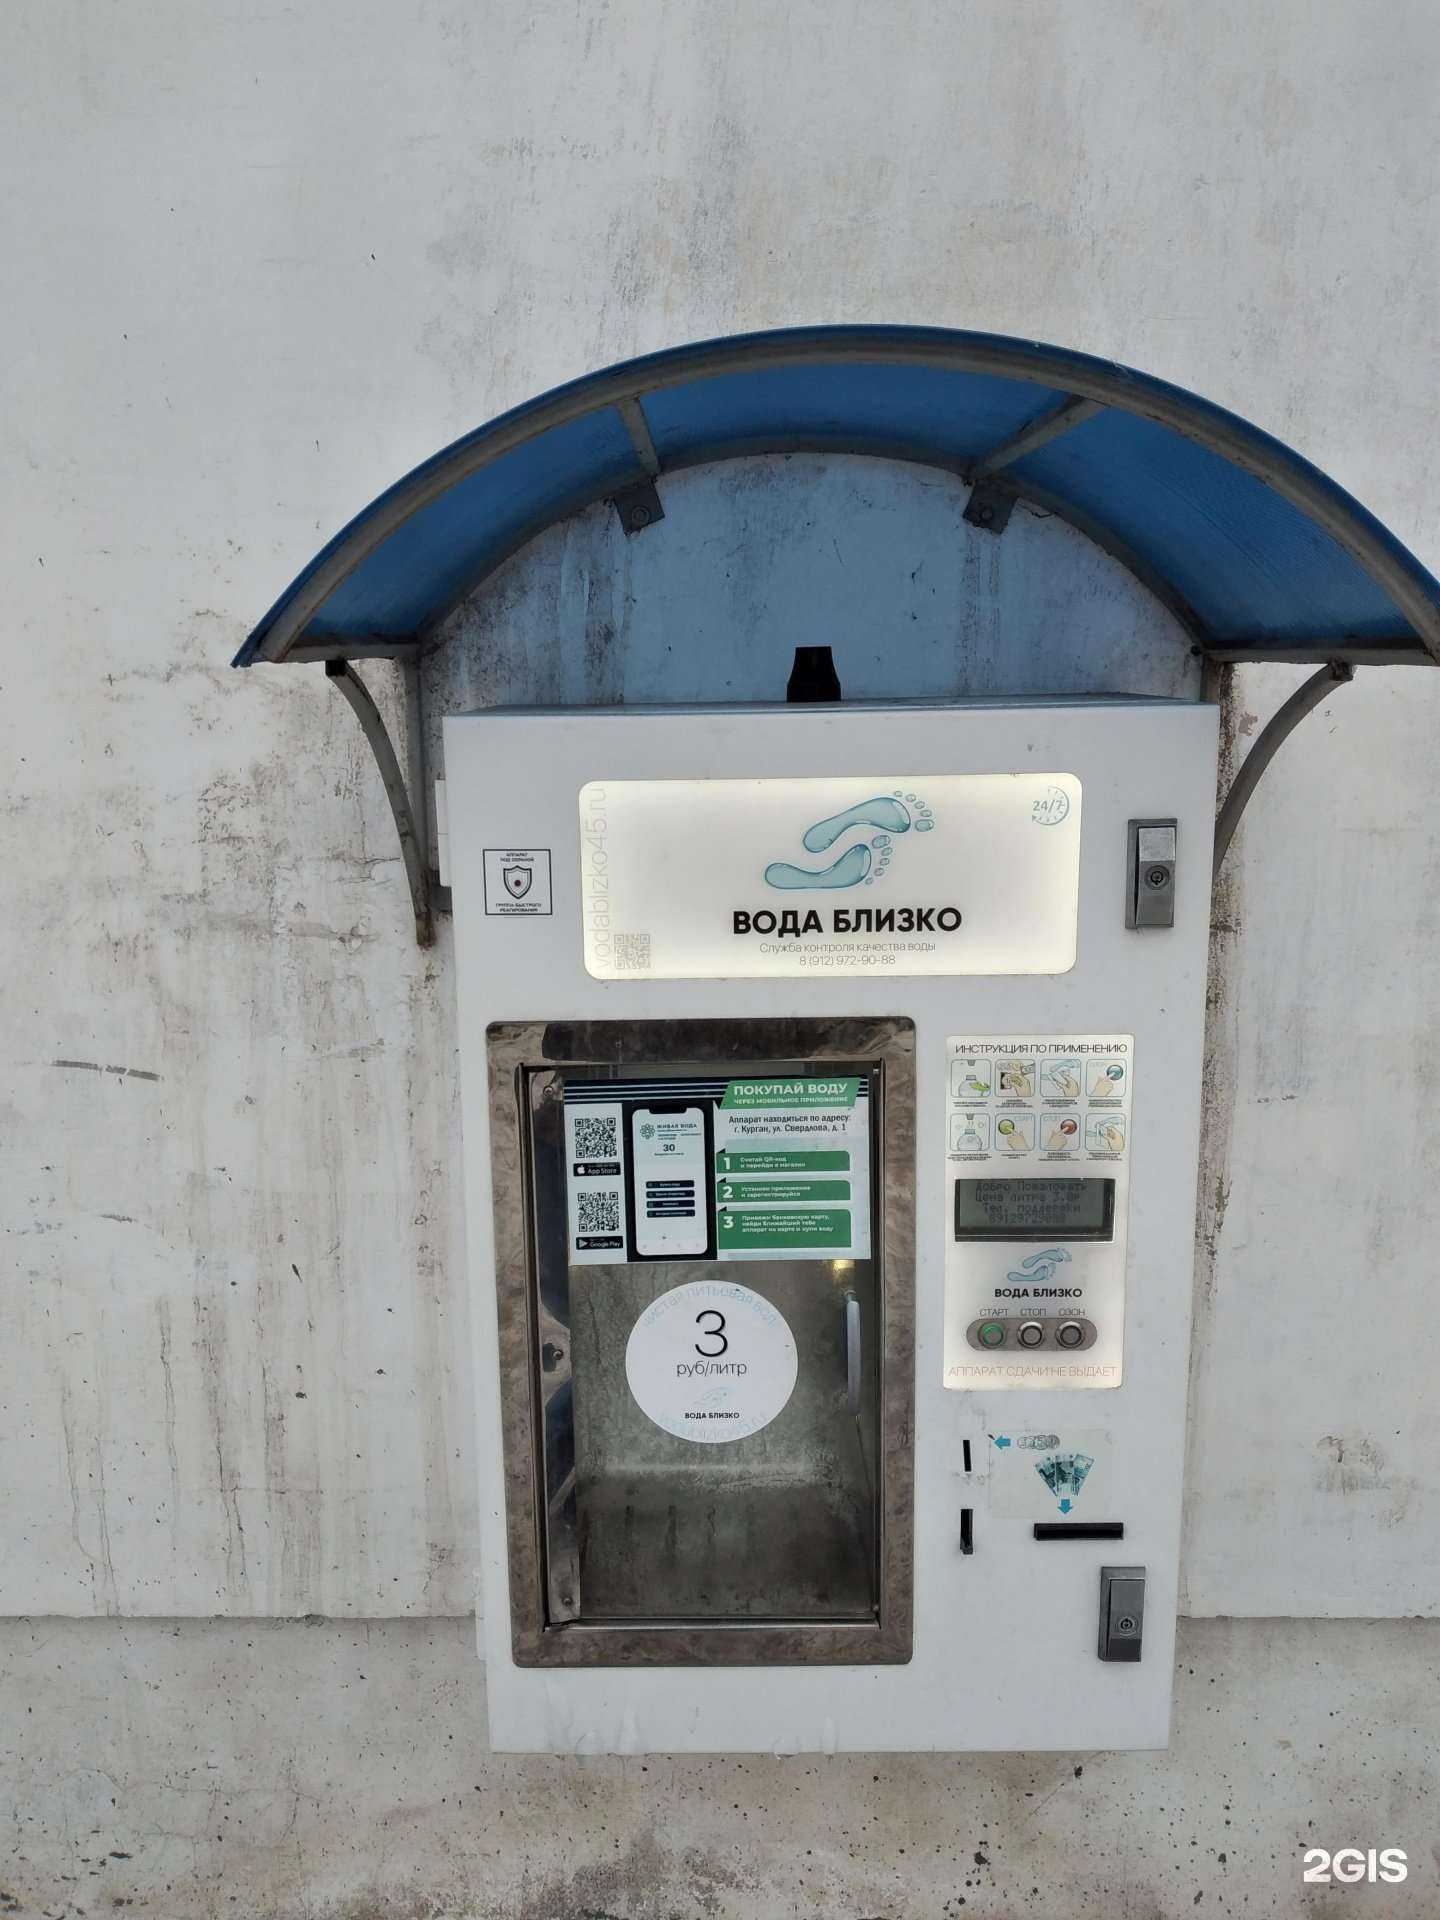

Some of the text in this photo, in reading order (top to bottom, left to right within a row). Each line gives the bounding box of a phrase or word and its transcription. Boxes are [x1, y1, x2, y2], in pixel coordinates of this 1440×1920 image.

[1033, 799, 1062, 813] 24/7
[584, 787, 610, 968] vodablizko45.ru
[733, 907, 962, 938] ВОДА БЛИЗКО
[759, 942, 936, 955] Служба контроля качества воды
[800, 954, 896, 967] 8 (912) 972-90-88
[955, 1043, 1127, 1054] ИНСТРУКЦИЯ ПО ПРИМЕНЕНИЮ
[734, 1082, 848, 1096] ПОКУПАЙ ВОДУ
[729, 1116, 762, 1125] Аппарат
[763, 1115, 808, 1124] находиться
[741, 1125, 771, 1135] Курган,
[772, 1125, 782, 1134] ул.
[784, 1124, 831, 1133] Свердлова,
[663, 1144, 675, 1152] 30
[723, 1157, 731, 1170] 1
[723, 1186, 734, 1198] 2
[723, 1216, 734, 1229] 3
[609, 1240, 621, 1248] Play
[994, 1288, 1083, 1299] ВОДА БЛИЗКО
[979, 1308, 1086, 1317] СТАРТ СТОП ОЗОН
[695, 1310, 728, 1357] 3
[676, 1360, 747, 1377] руб/литр
[949, 1366, 1117, 1378] АППАРАТ СДАЧИ НЕ ВЫДАЕТ
[684, 1412, 706, 1420] ВОДА
